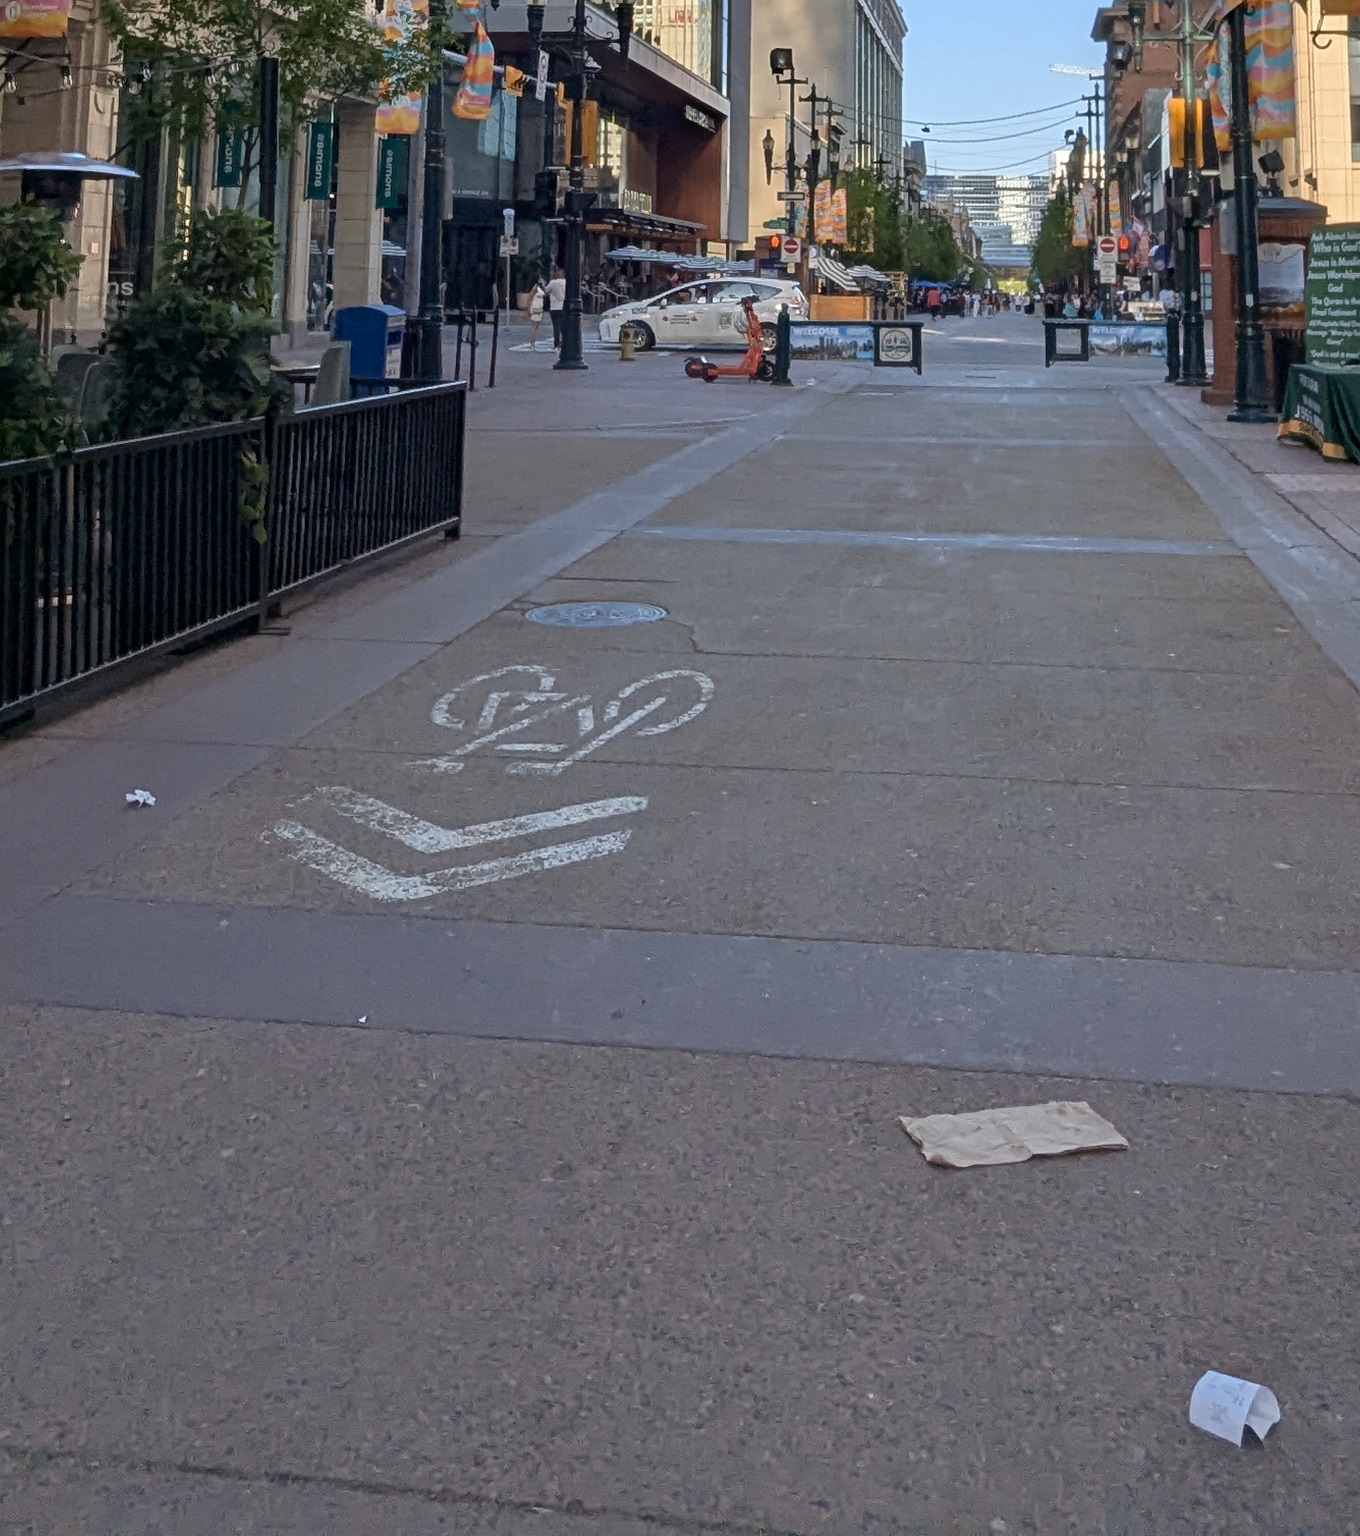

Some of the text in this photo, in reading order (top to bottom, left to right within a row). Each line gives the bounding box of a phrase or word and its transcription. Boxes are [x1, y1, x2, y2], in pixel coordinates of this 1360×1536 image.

[313, 141, 324, 188] simons
[384, 156, 394, 199] simons
[1312, 243, 1332, 253] Who
[1333, 242, 1340, 252] is
[1327, 283, 1344, 293] God
